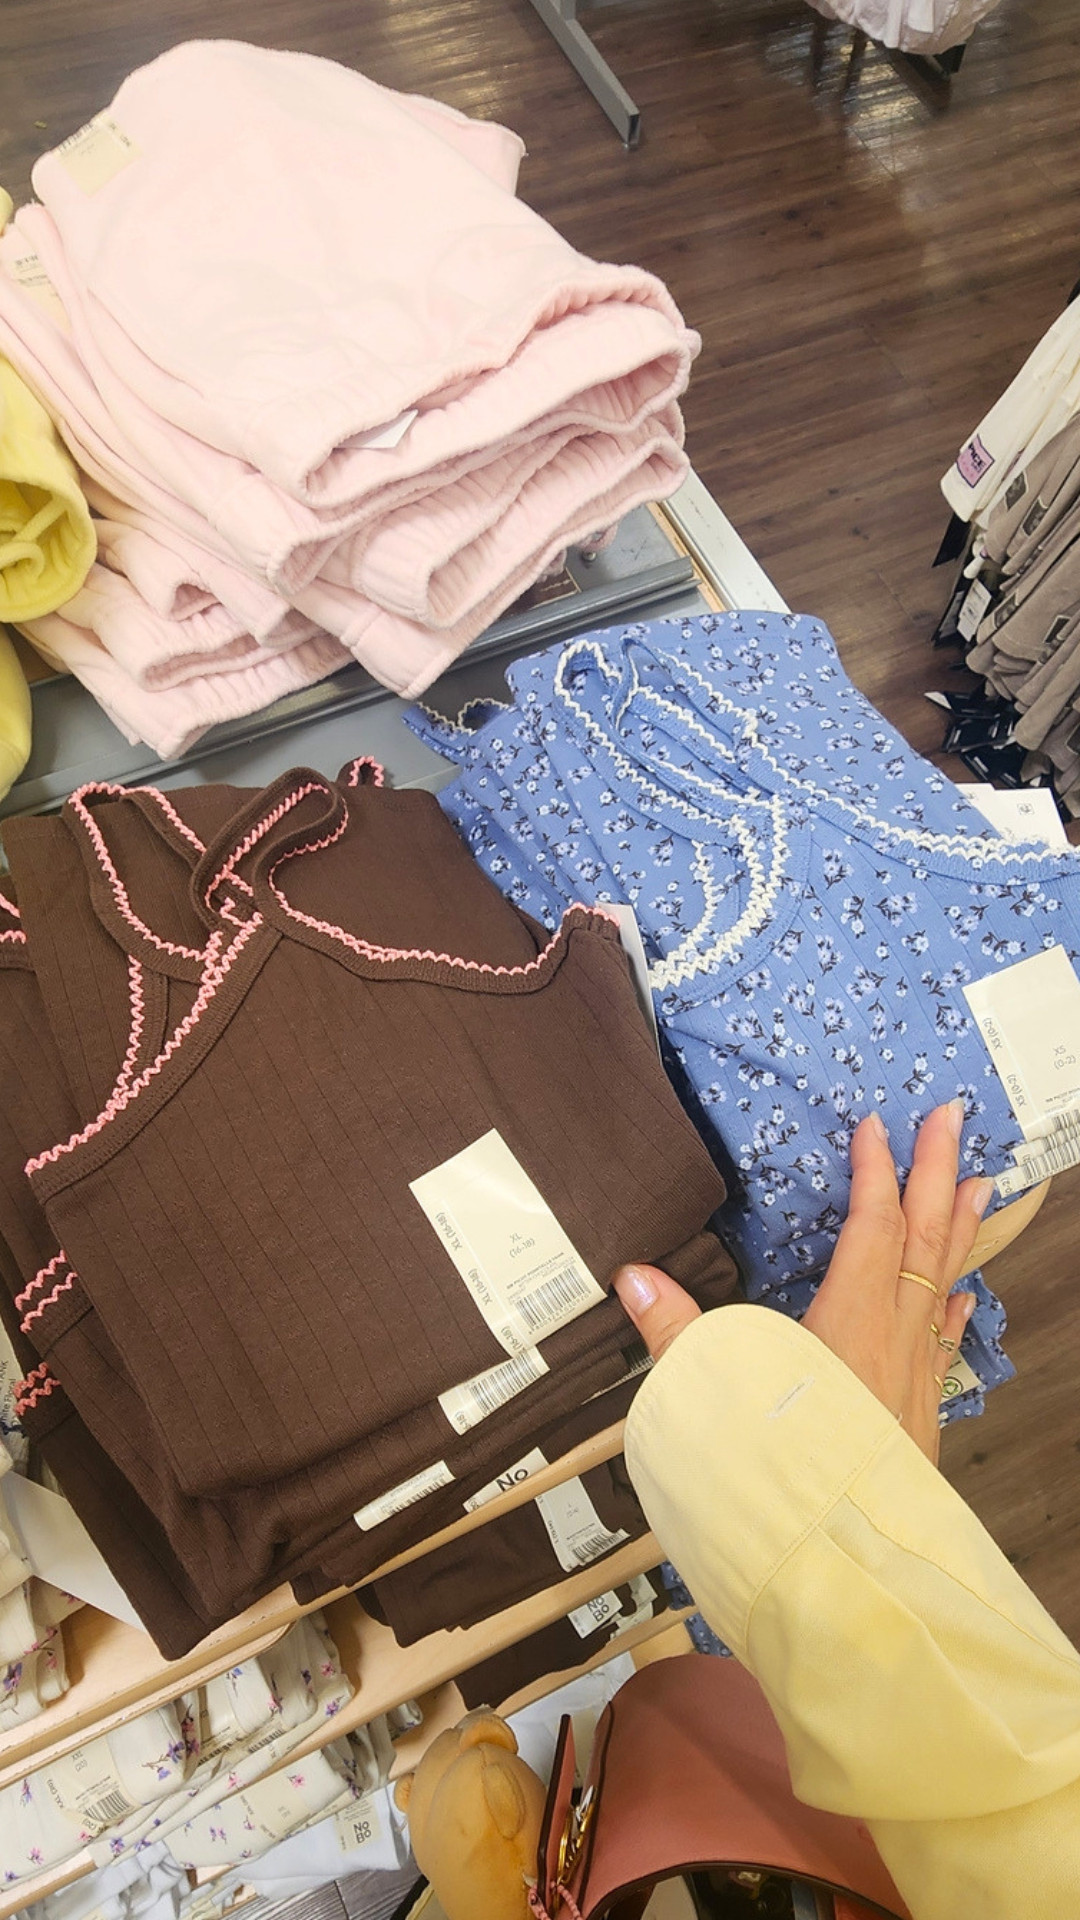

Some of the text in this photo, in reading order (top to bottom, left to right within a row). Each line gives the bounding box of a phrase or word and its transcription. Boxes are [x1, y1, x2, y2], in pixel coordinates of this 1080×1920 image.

[982, 1017, 1003, 1049] XS (0-2)
[1053, 1045, 1066, 1056] XS
[1054, 1055, 1077, 1070] (0-2)
[1006, 1074, 1027, 1107] XS (0-2)
[451, 1238, 463, 1251] XL
[510, 1233, 522, 1243] XL
[509, 1238, 536, 1258] (16-18)
[482, 1292, 493, 1305] XL
